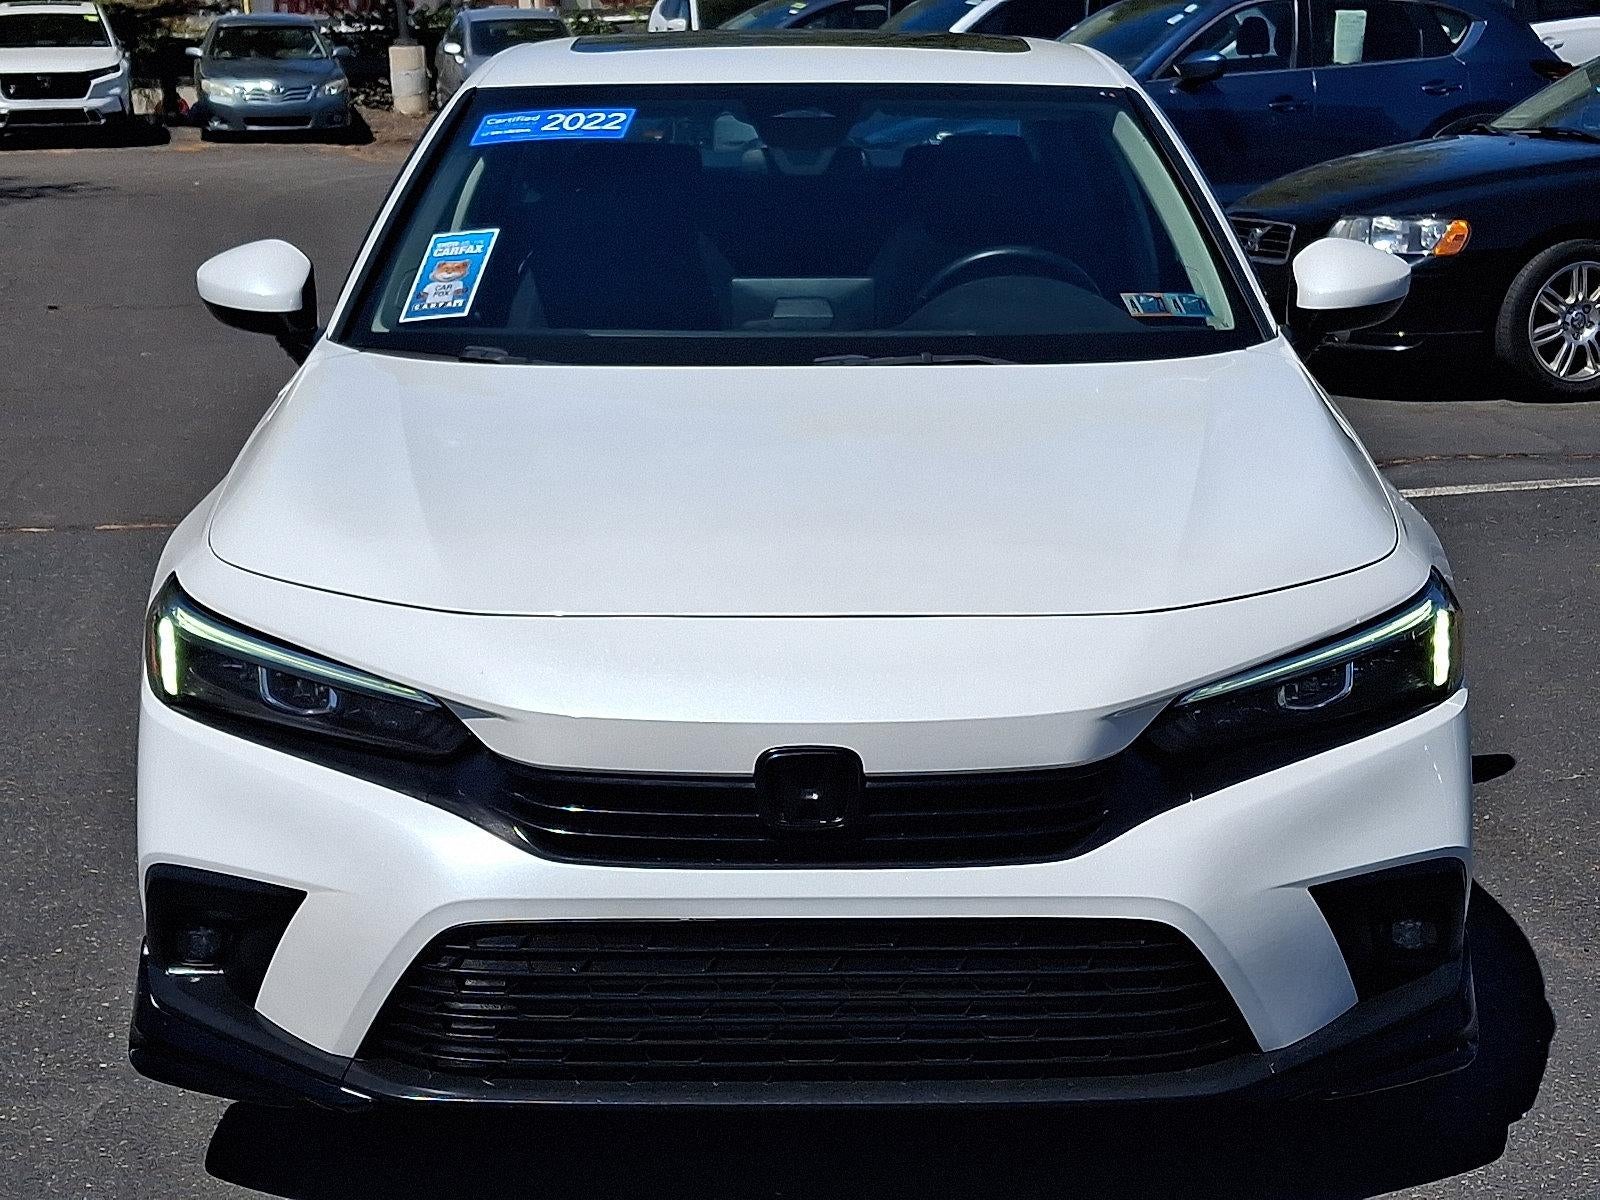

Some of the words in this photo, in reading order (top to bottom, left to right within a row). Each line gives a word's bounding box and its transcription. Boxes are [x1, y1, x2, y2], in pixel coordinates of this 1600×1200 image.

[486, 114, 541, 125] Certified
[540, 112, 627, 131] 2022
[432, 244, 485, 257] CARFAX
[435, 284, 453, 292] CAR
